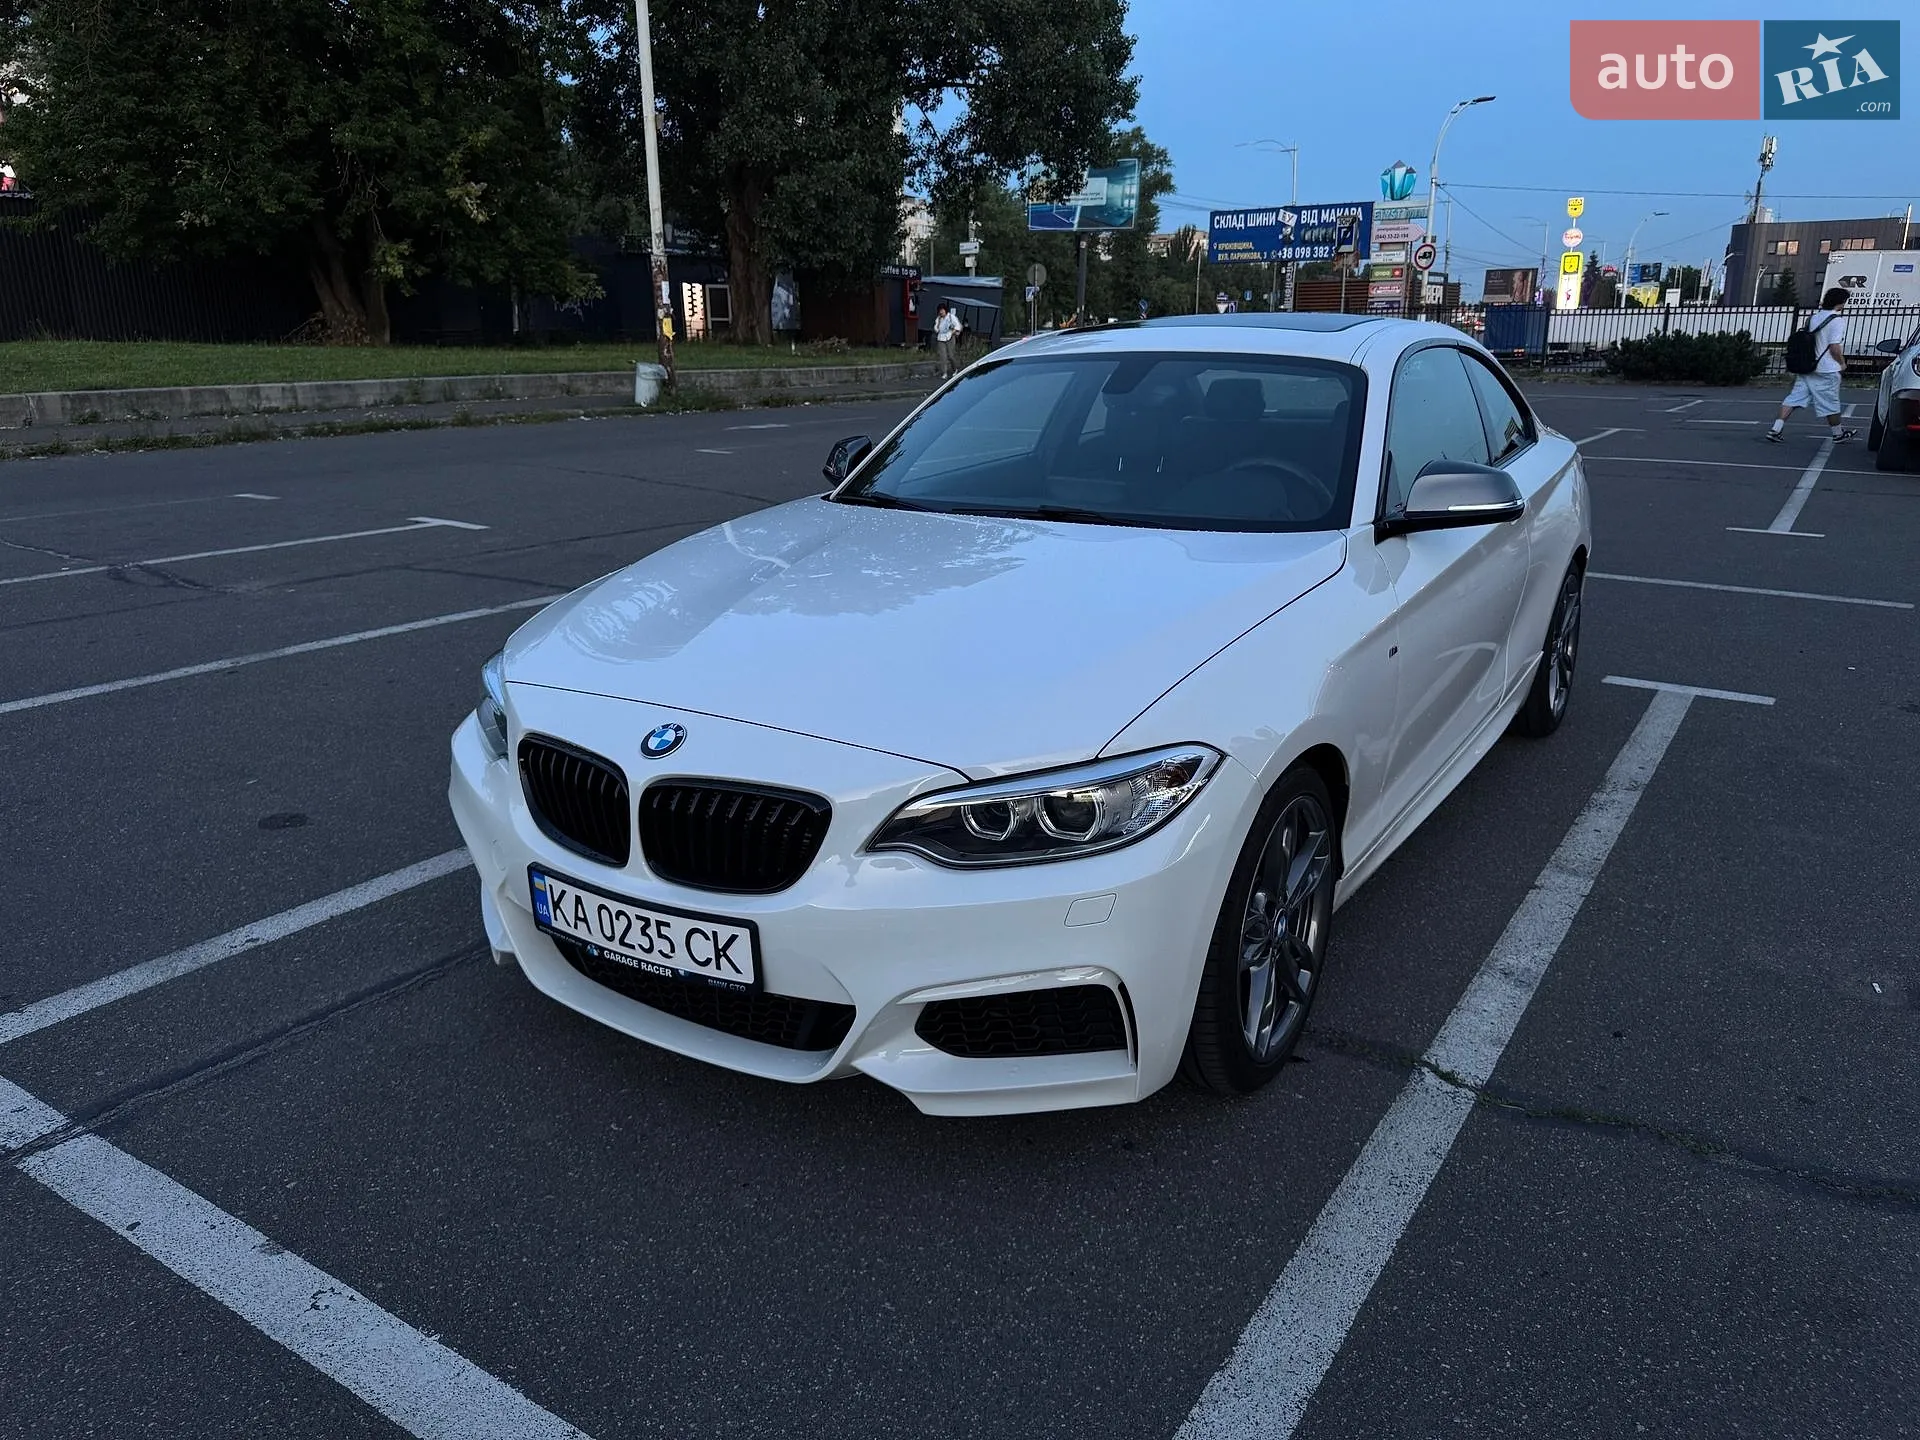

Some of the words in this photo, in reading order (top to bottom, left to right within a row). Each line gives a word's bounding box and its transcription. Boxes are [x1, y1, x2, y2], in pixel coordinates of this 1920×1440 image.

[1214, 213, 1245, 230] СКЛАД
[1247, 211, 1277, 227] ШИНИ
[1301, 209, 1318, 226] ВІД
[1277, 247, 1293, 259] +38
[1295, 246, 1311, 259] 098
[1313, 245, 1329, 258] 382
[537, 902, 550, 917] UA
[549, 884, 592, 936] KA
[597, 904, 675, 959] 0235
[685, 927, 744, 975] CK
[604, 950, 639, 968] GARAGE
[641, 962, 672, 978] RACER
